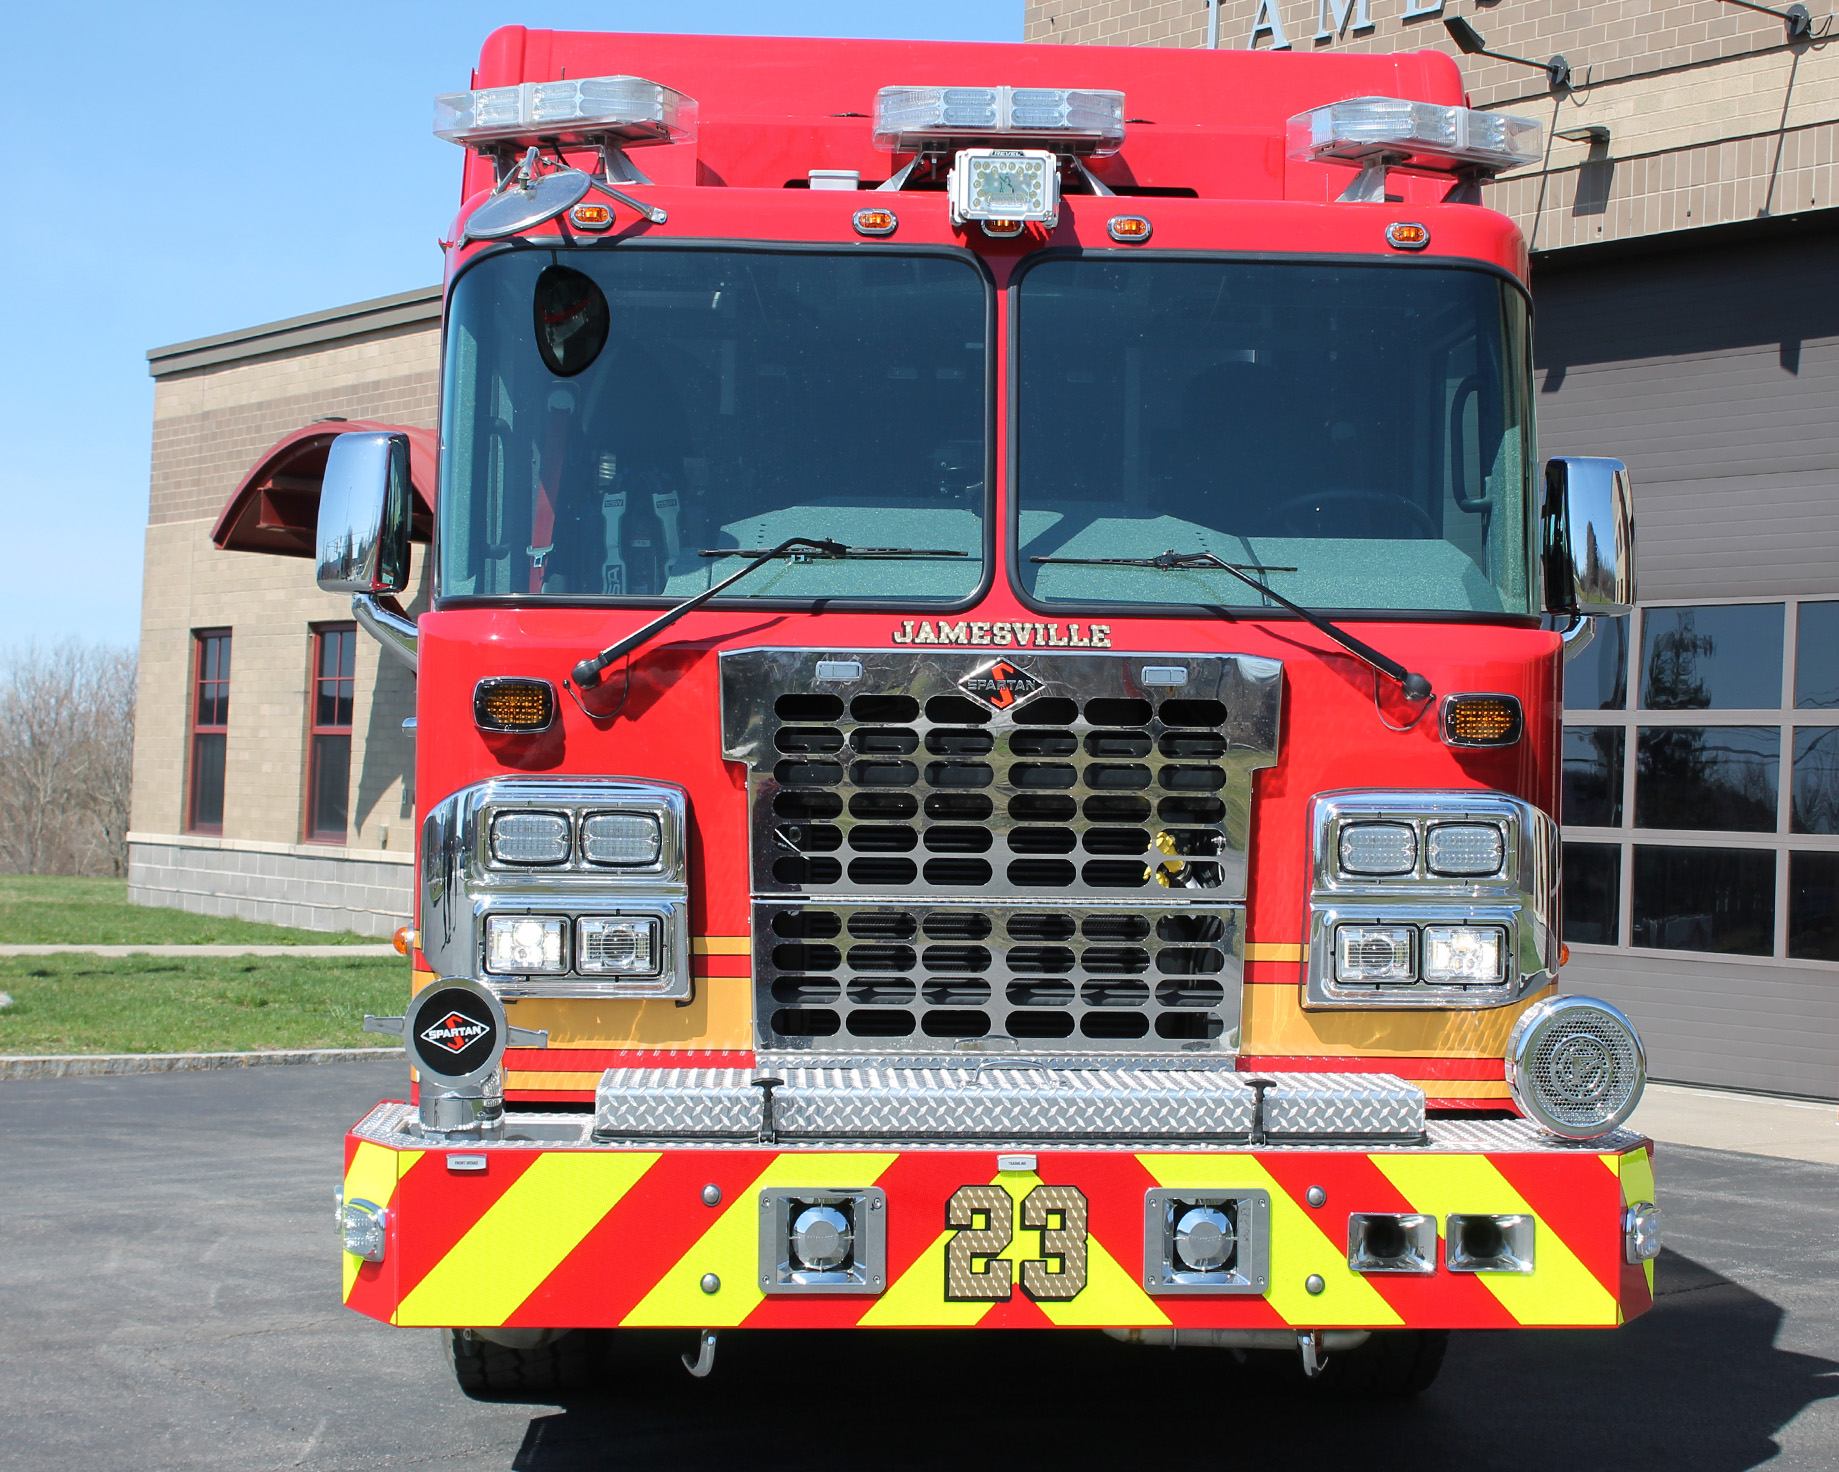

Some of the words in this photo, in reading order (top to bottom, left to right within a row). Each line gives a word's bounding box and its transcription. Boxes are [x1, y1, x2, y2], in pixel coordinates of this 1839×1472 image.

[892, 619, 1112, 648] JAMESVILLE
[967, 678, 1037, 691] SPARTAN
[428, 1025, 482, 1040] SPARTAN
[944, 1185, 1088, 1302] 23
